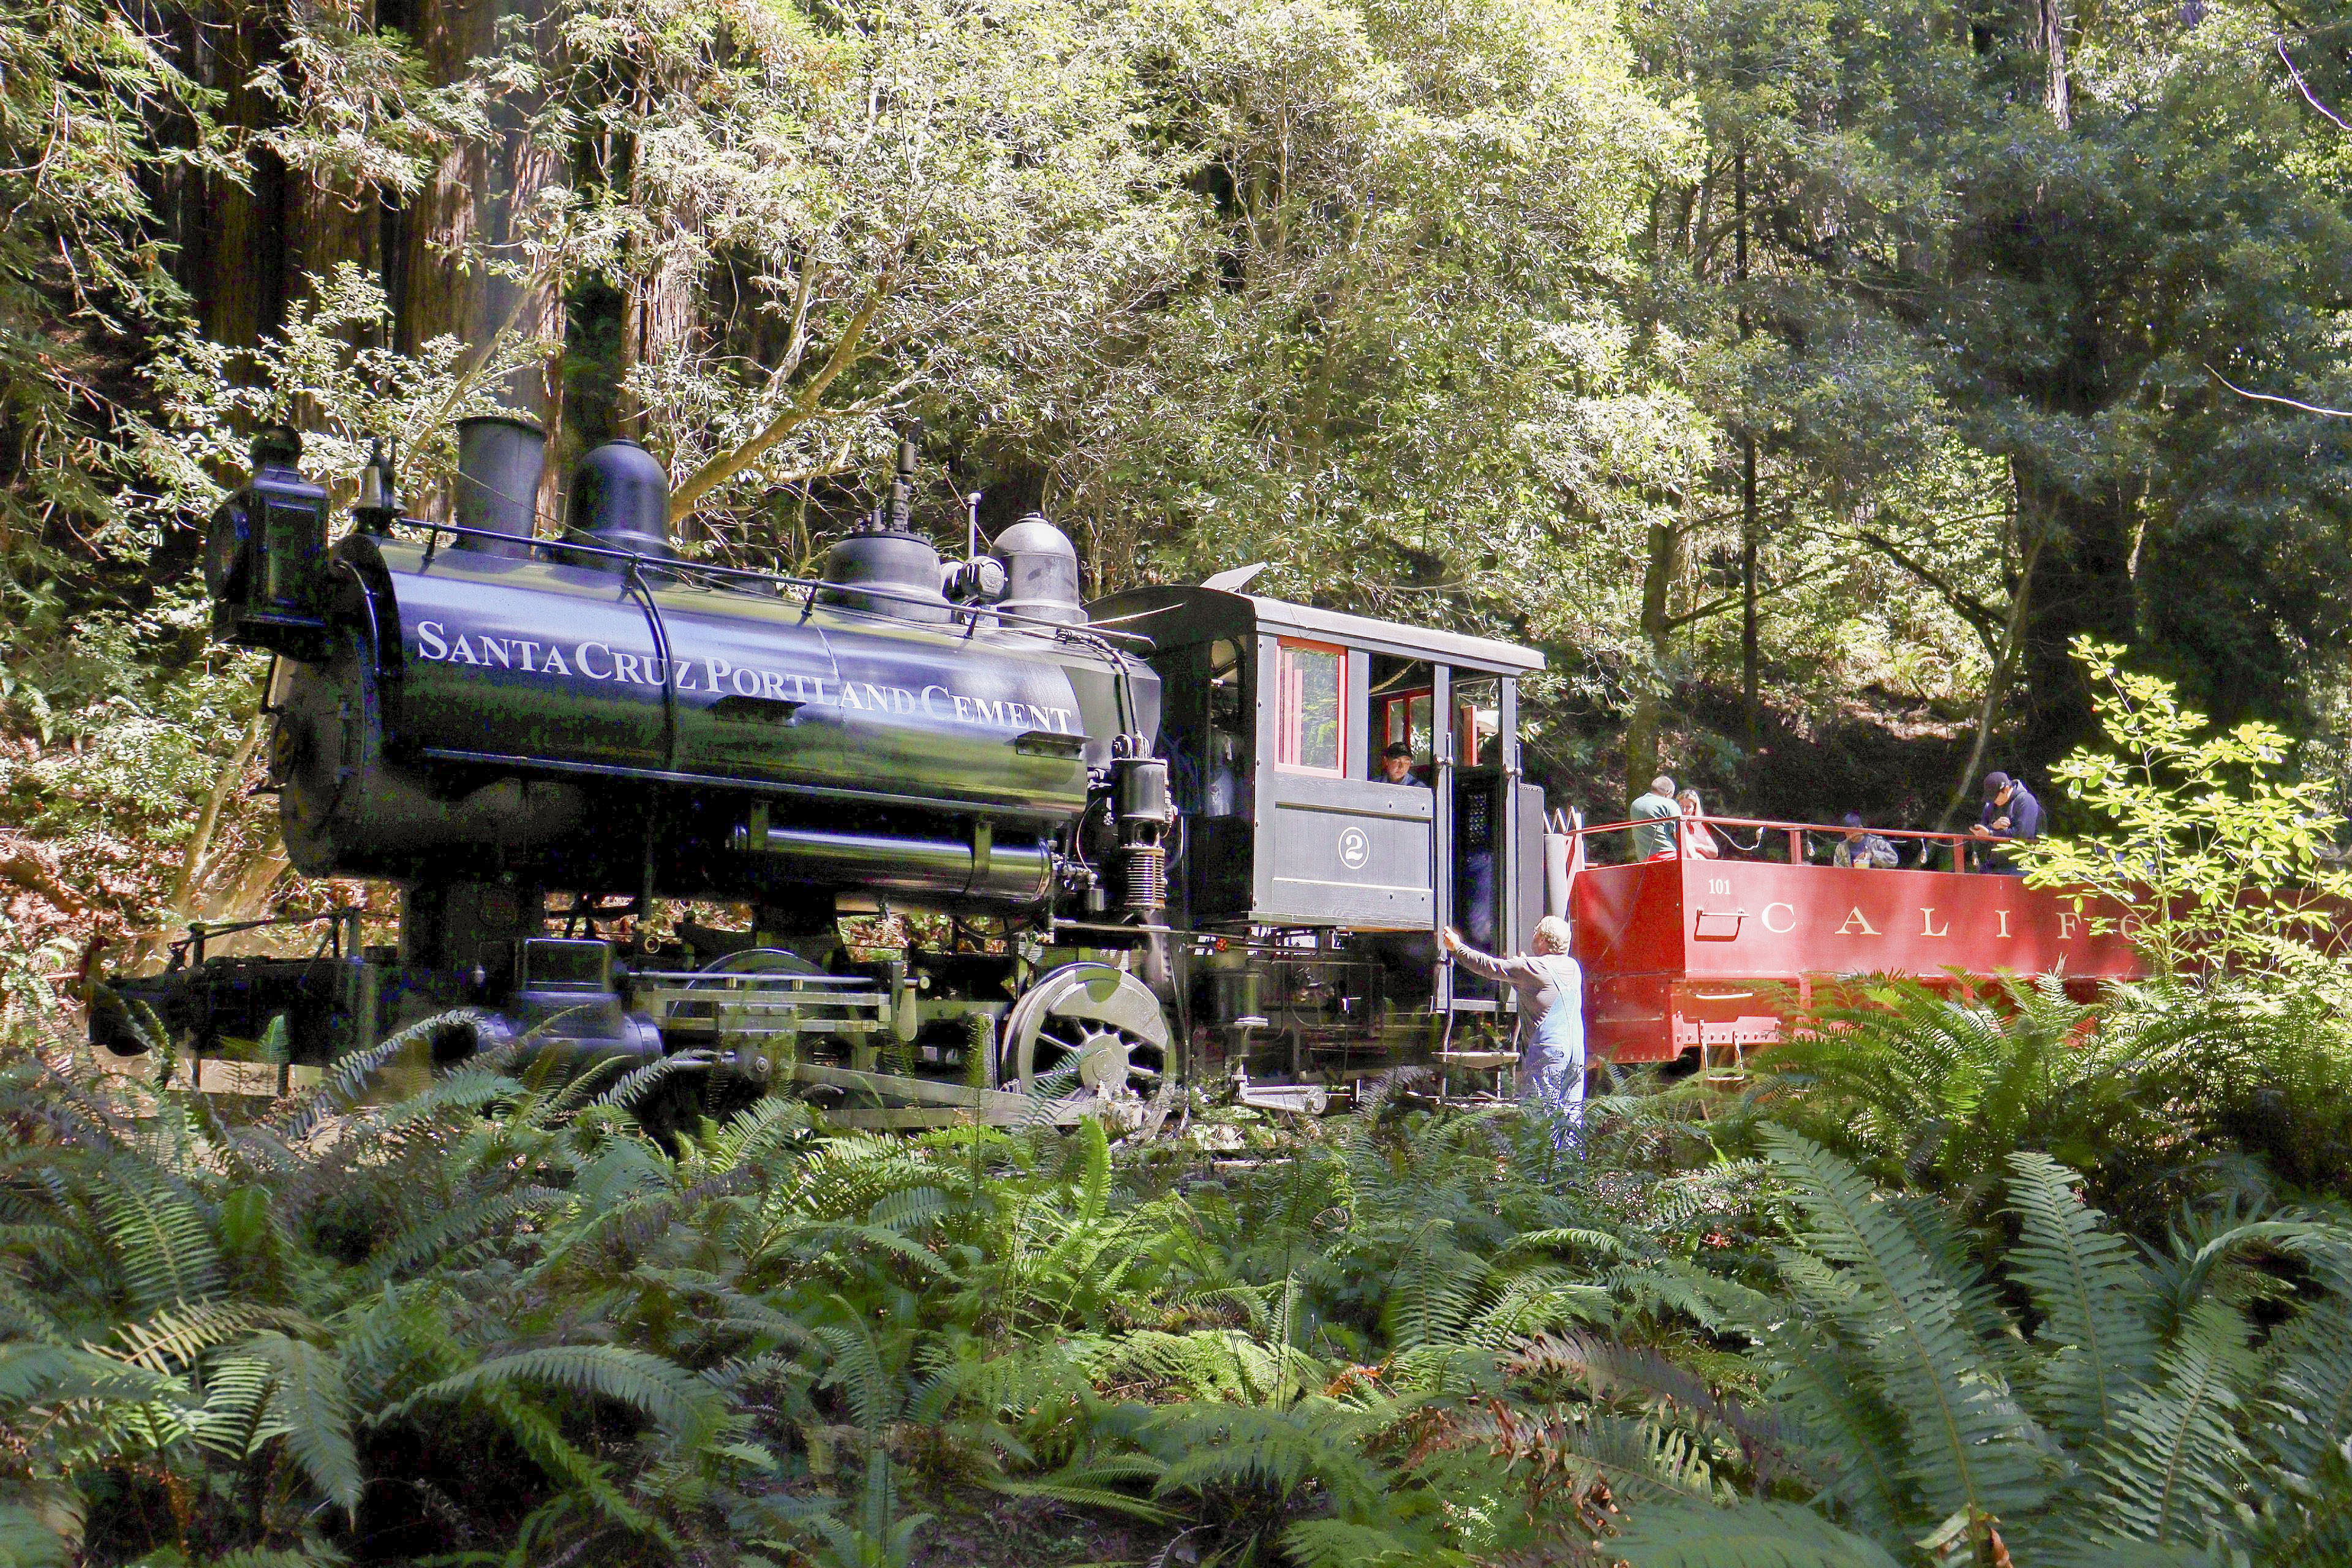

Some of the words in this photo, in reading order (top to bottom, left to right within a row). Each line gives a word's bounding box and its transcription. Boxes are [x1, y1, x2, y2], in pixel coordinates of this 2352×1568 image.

[417, 620, 573, 676] SANTA
[575, 641, 696, 690] CRUZ
[704, 655, 916, 715] PORTLAND
[920, 685, 1072, 735] CEMENT
[1345, 834, 1364, 861] 2
[1708, 878, 1731, 895] 101
